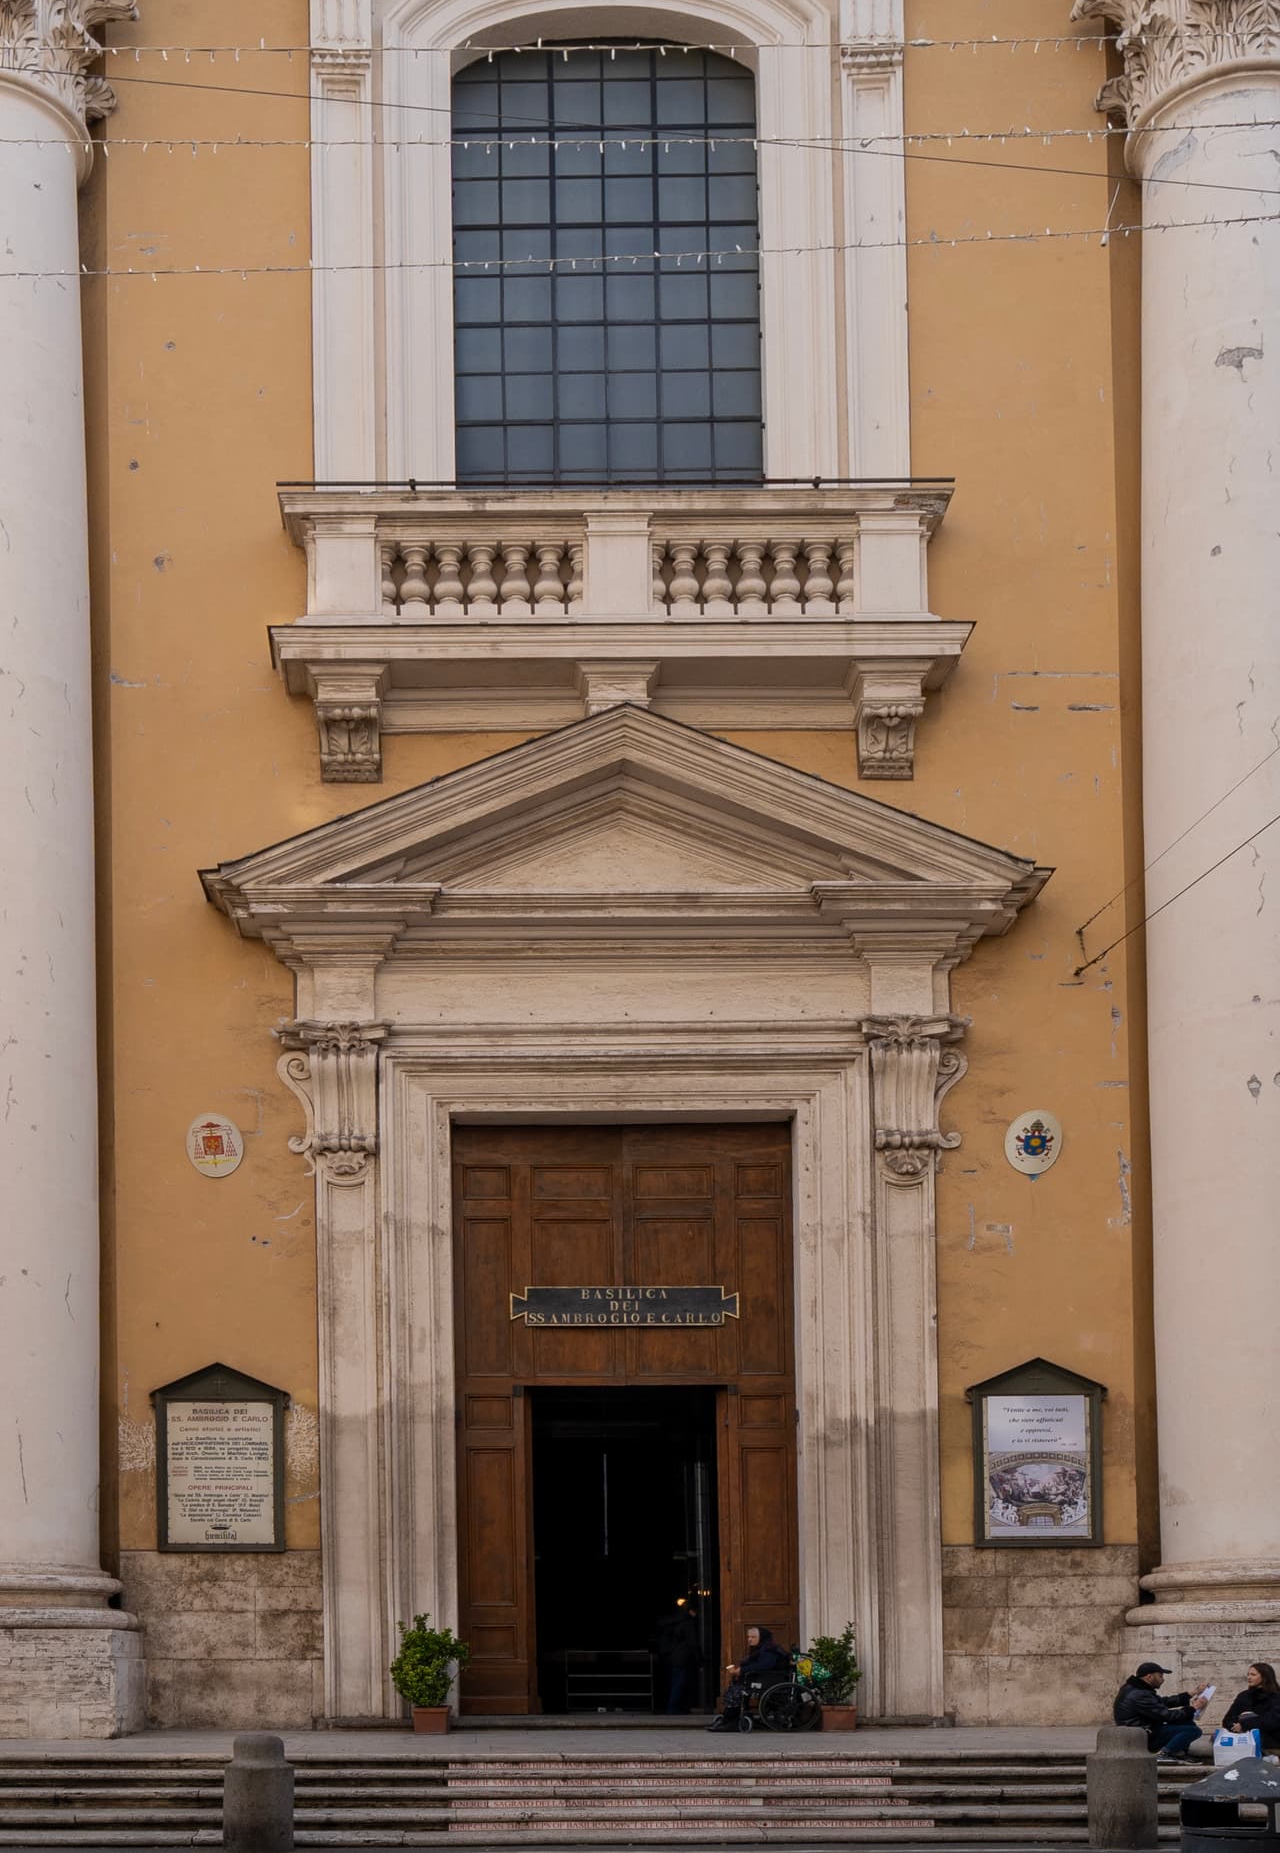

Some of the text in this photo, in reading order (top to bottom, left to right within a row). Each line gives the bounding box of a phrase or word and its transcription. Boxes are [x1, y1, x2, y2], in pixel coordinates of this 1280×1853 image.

[581, 1289, 668, 1299] BASILICA
[610, 1301, 639, 1311] DEI
[529, 1313, 721, 1323] SS AMBROGIO E CARLO
